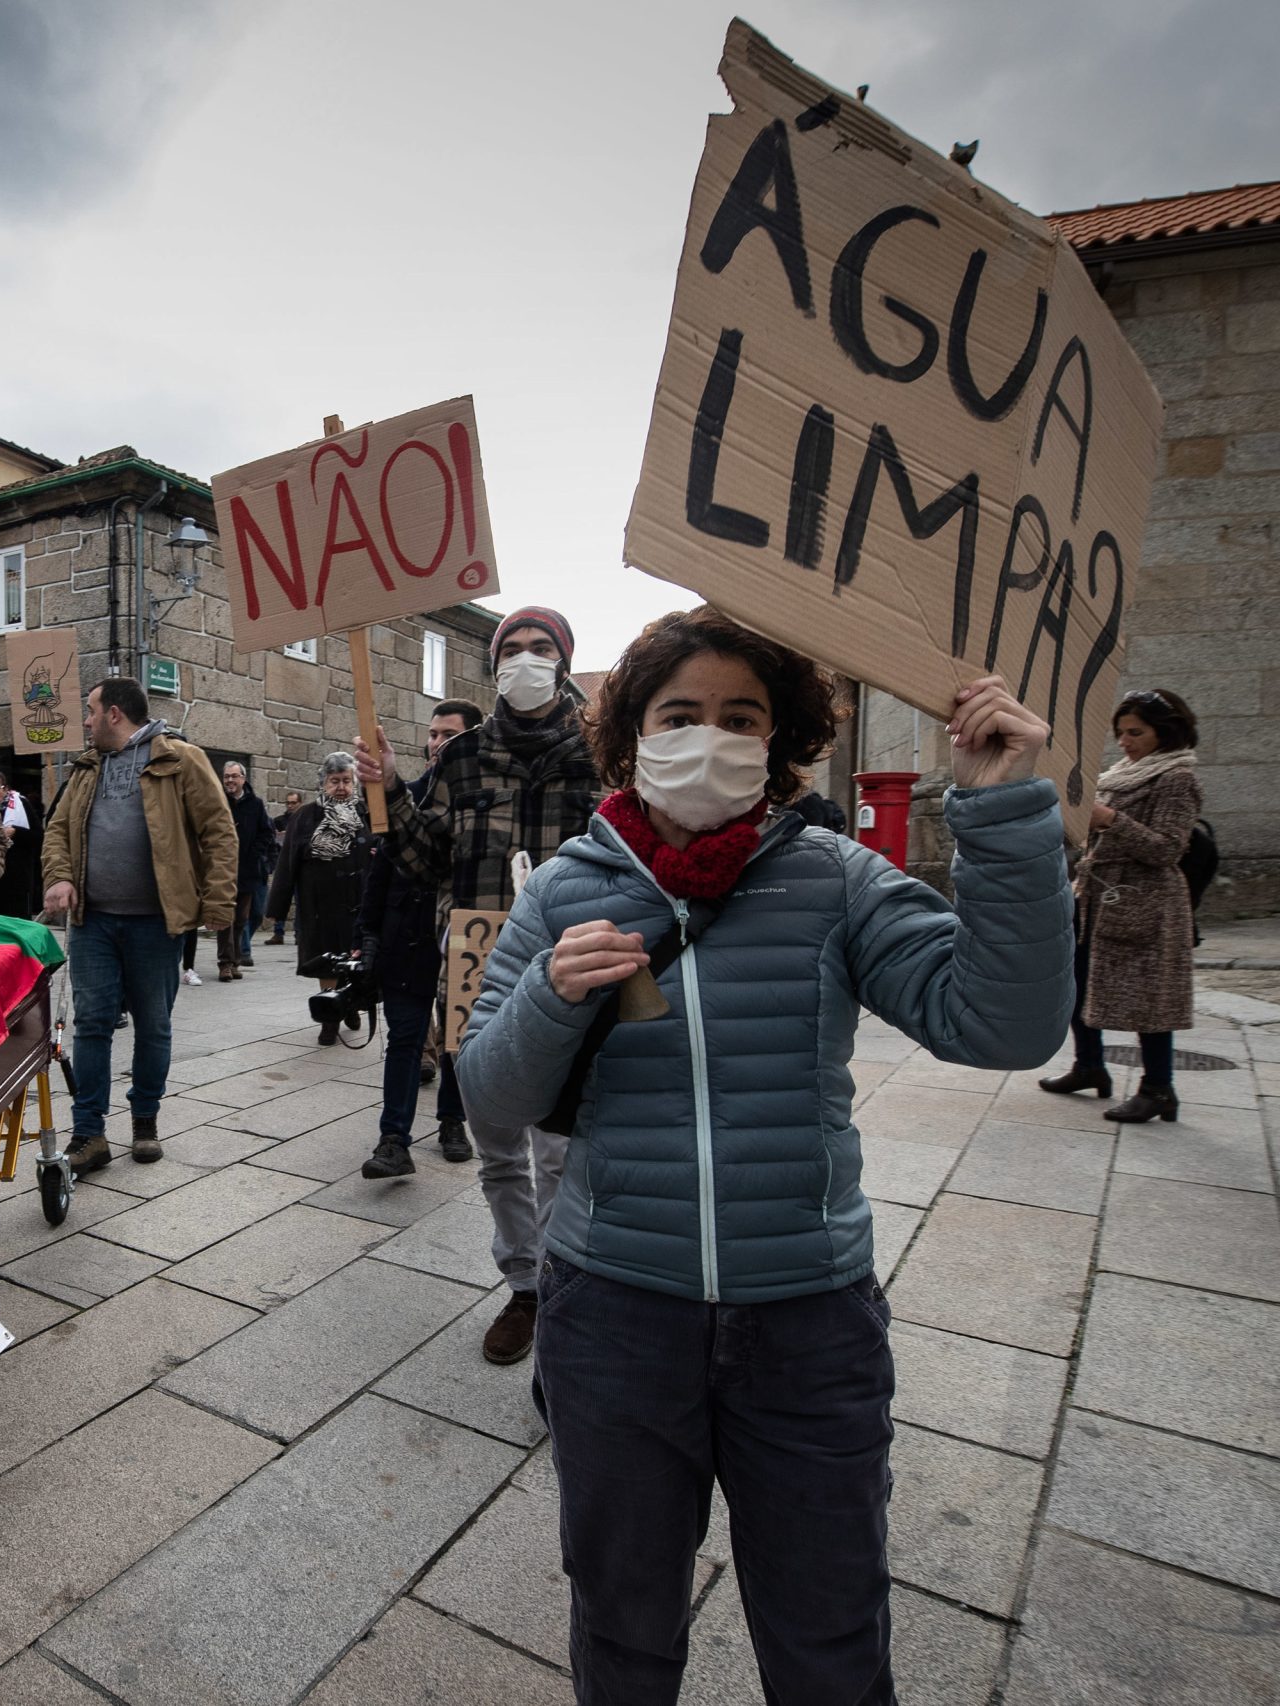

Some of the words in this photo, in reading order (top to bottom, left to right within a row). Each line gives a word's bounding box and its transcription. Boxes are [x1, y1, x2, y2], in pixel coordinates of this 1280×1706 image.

[700, 92, 1093, 525] ÁGUA
[230, 422, 489, 621] NÃO!
[686, 328, 1123, 807] LIMPA?
[746, 887, 787, 895] Quechua
